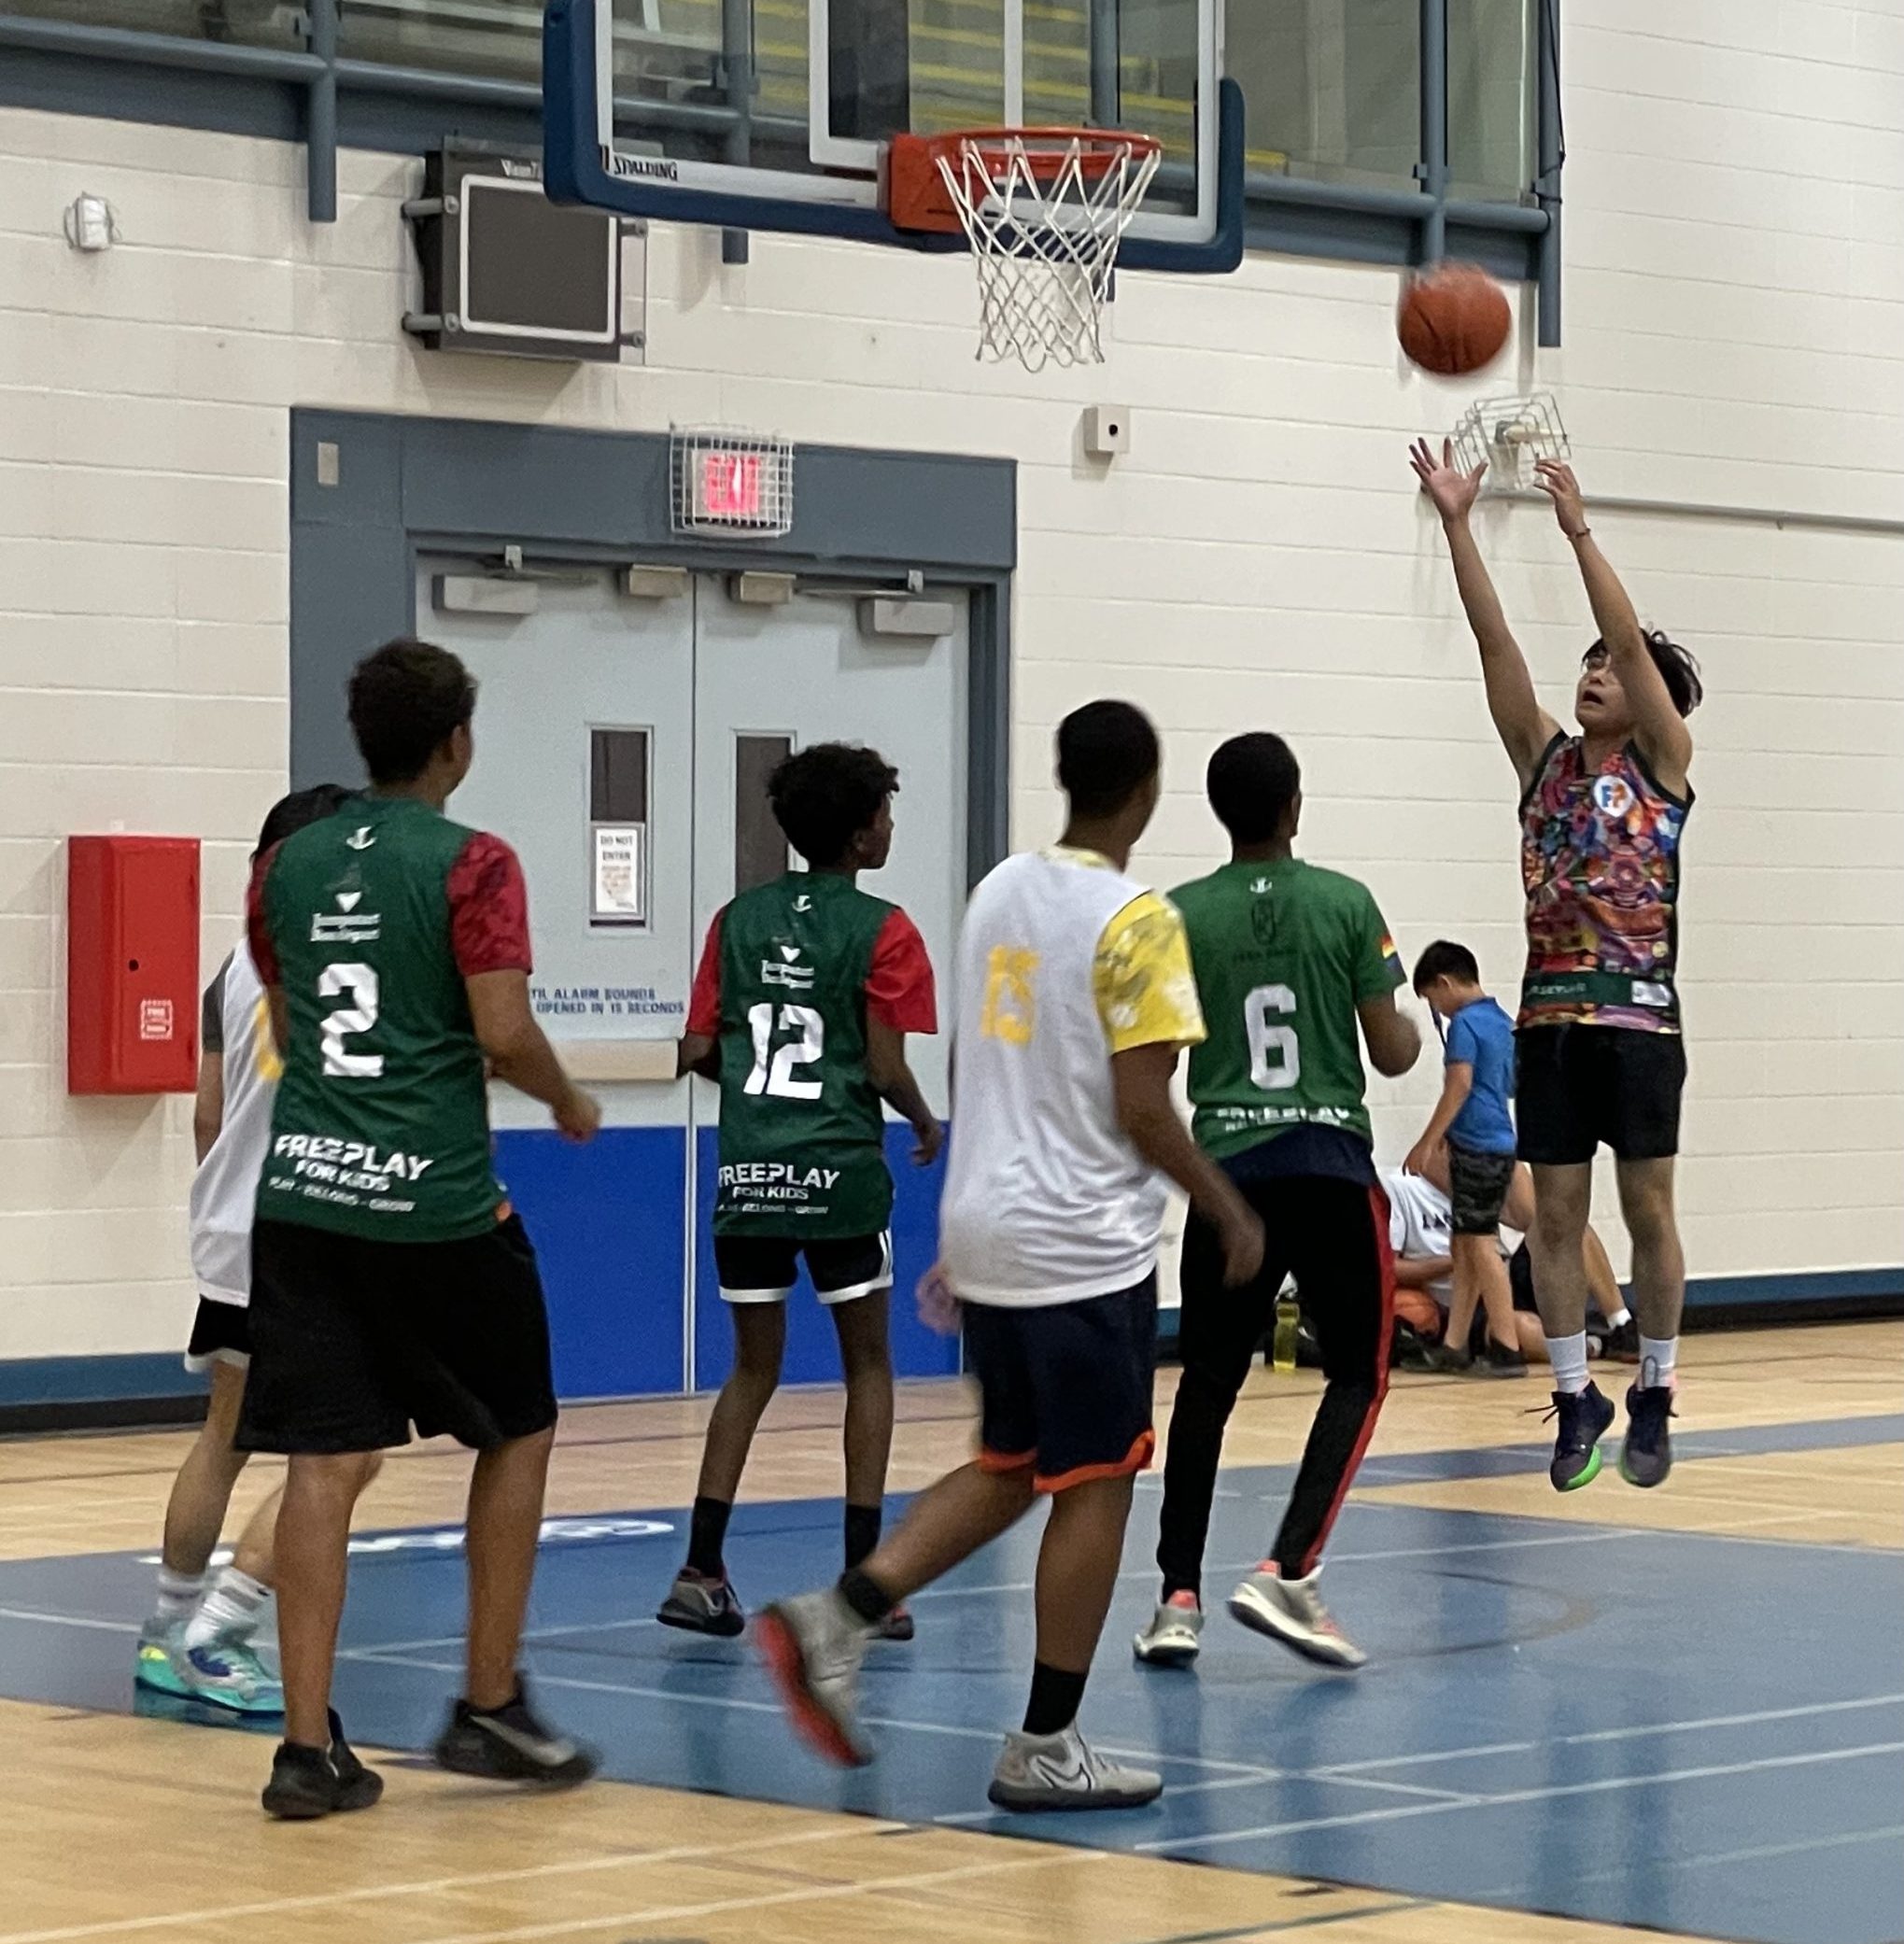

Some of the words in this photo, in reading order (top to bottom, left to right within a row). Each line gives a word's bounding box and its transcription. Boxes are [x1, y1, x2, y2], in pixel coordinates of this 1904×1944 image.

[614, 157, 678, 181] SPALDING
[615, 836, 632, 845] NOT
[536, 1002, 586, 1015] OPENED
[591, 1003, 603, 1015] IN
[628, 1001, 684, 1014] SECONDS
[554, 988, 599, 1000] ALARM
[604, 988, 656, 1001] SOUNDS
[318, 963, 385, 1078] 2
[1244, 983, 1301, 1090] 6
[743, 1002, 825, 1100] 12
[275, 1134, 434, 1181] FREEPLAY
[294, 1159, 339, 1184] FOR
[336, 1167, 392, 1192] KIDS
[732, 1186, 766, 1199] FOR
[767, 1186, 810, 1200] KIDS
